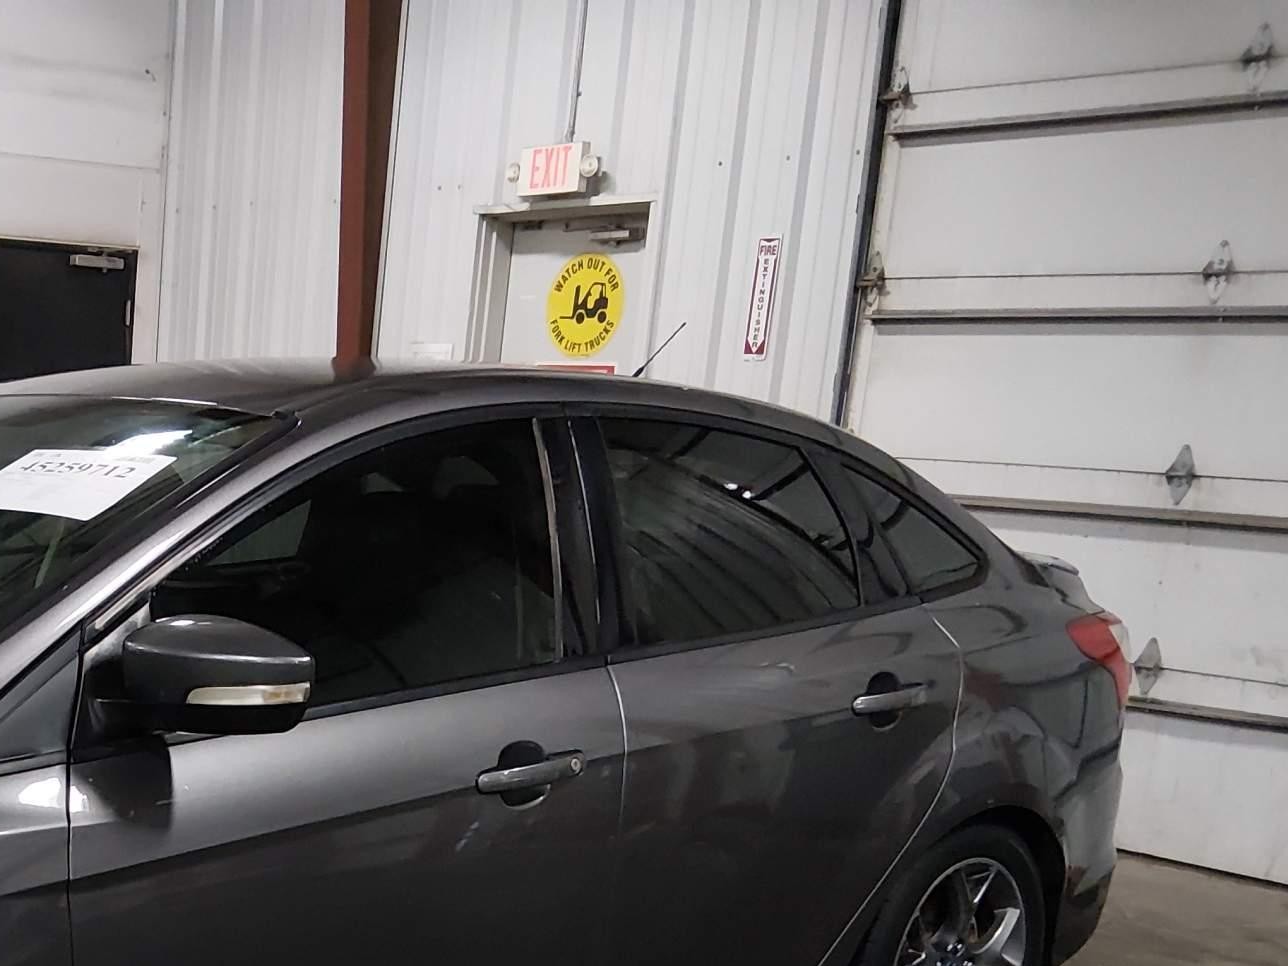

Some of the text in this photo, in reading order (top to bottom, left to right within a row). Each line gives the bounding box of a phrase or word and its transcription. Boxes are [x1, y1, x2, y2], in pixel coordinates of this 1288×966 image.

[529, 146, 572, 189] EXIT
[760, 245, 777, 255] FIRE
[554, 257, 619, 292] WATCH OUT FOR
[752, 258, 769, 348] EXTINGUISHER
[550, 319, 614, 352] FORK LIFT TRUCKS
[20, 461, 136, 478] 45259712
